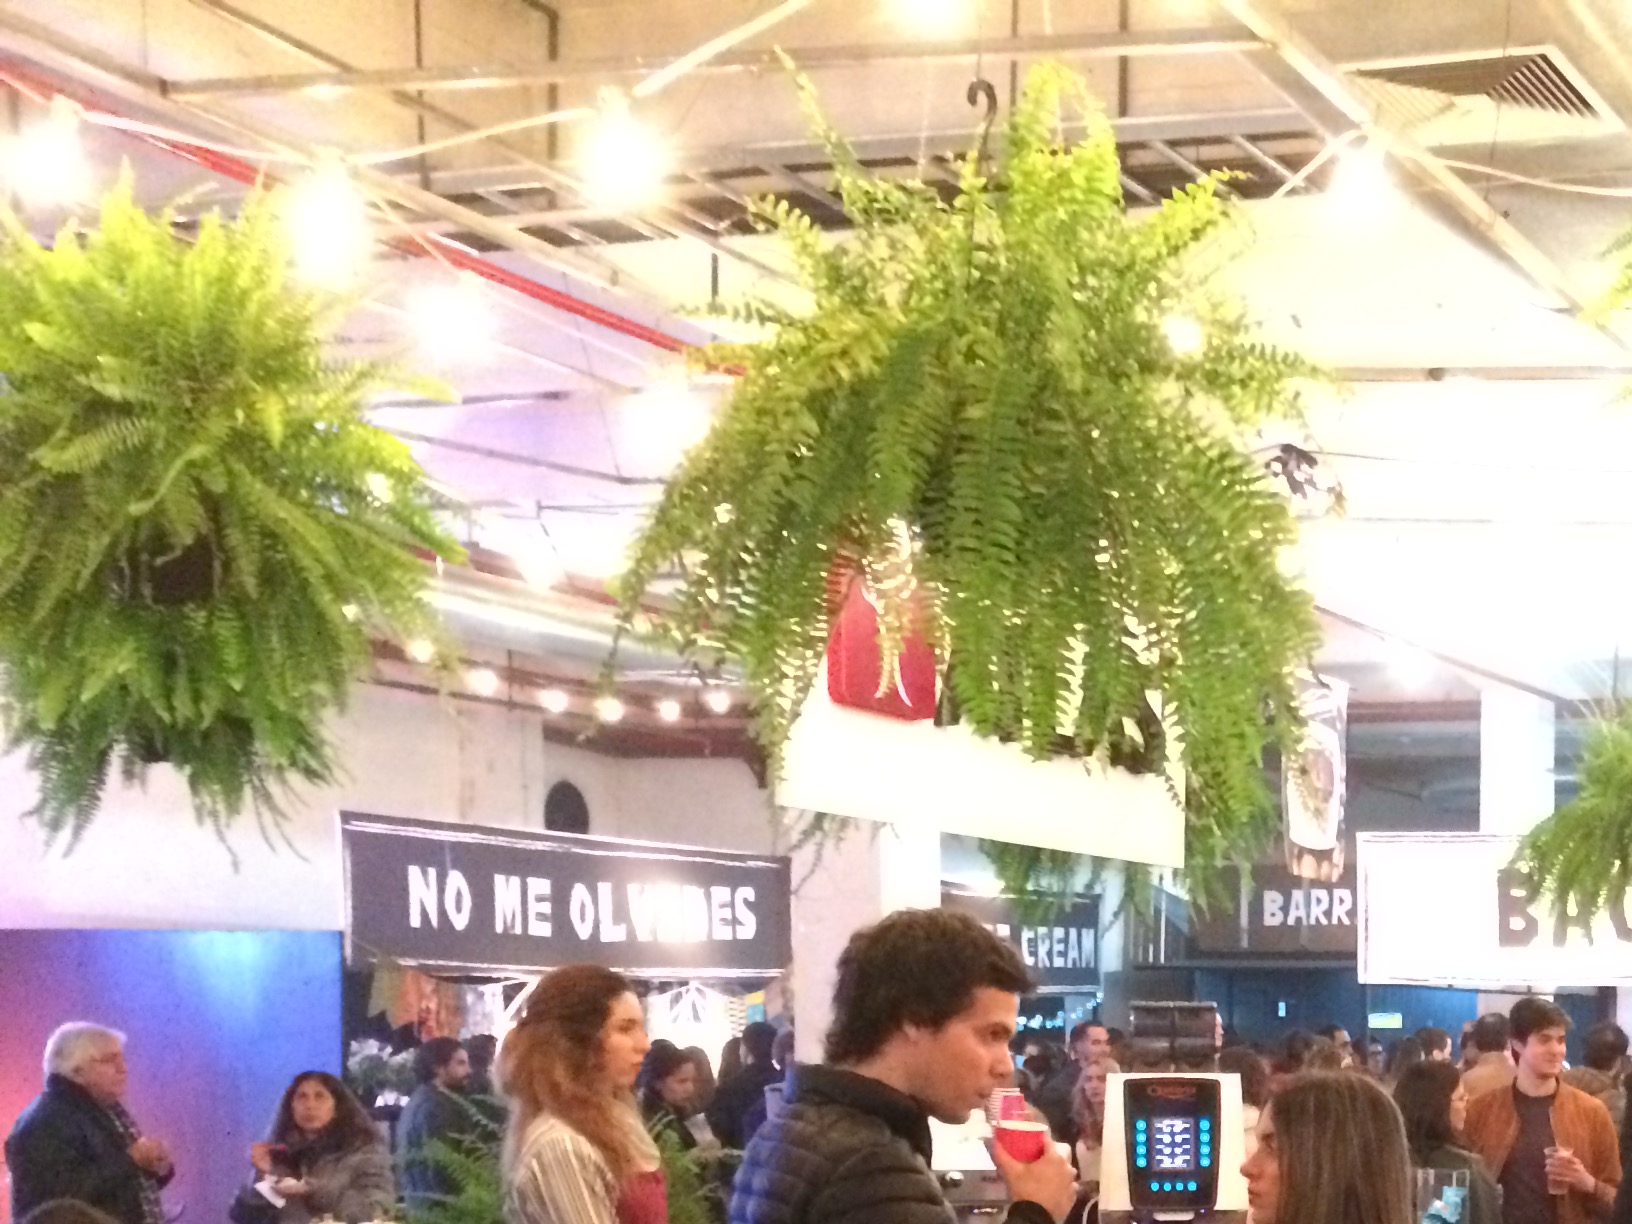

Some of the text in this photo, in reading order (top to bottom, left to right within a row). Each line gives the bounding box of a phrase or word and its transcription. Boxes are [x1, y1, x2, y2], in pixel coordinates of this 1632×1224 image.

[407, 864, 472, 931] NO
[493, 872, 553, 937] ME
[1262, 888, 1358, 926] BARR
[1021, 926, 1095, 969] CREAM
